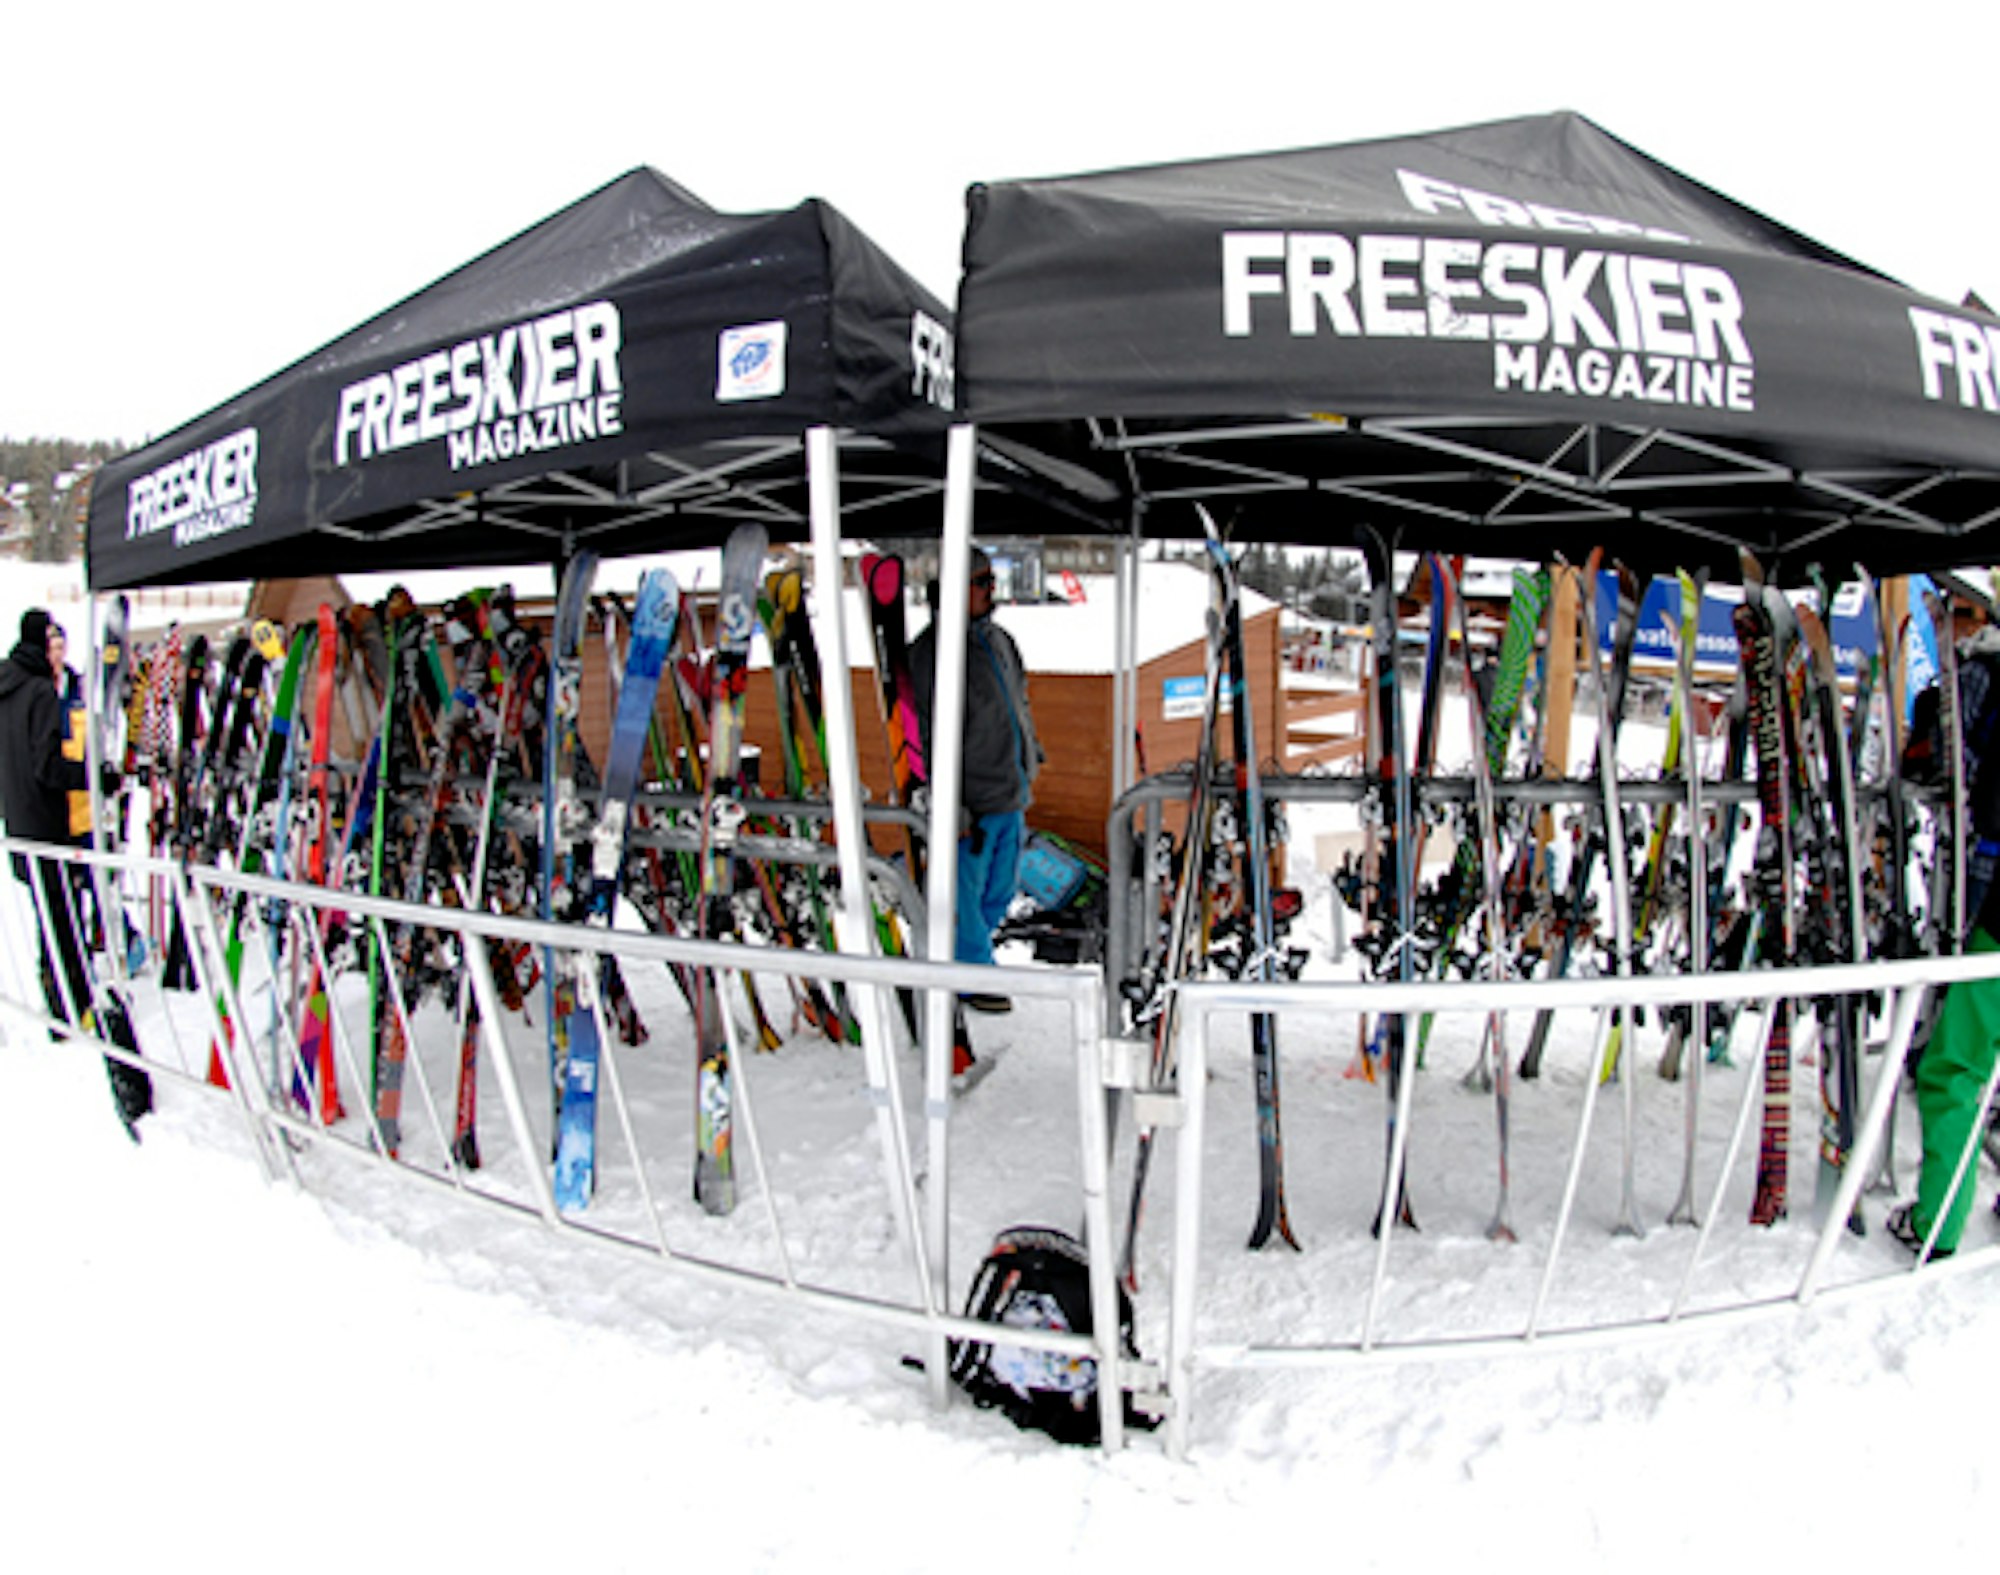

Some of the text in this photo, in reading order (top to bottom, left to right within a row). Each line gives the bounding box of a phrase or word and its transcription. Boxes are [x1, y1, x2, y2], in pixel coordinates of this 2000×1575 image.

[1222, 231, 1755, 363] FREESKIER
[334, 300, 621, 466] FREESKIER
[1494, 343, 1755, 410] MAGAZINE
[1908, 305, 2000, 415] FR
[125, 427, 258, 541] FREESKIER
[448, 392, 622, 470] MAGAZINE
[174, 497, 257, 549] MAGAZINE
